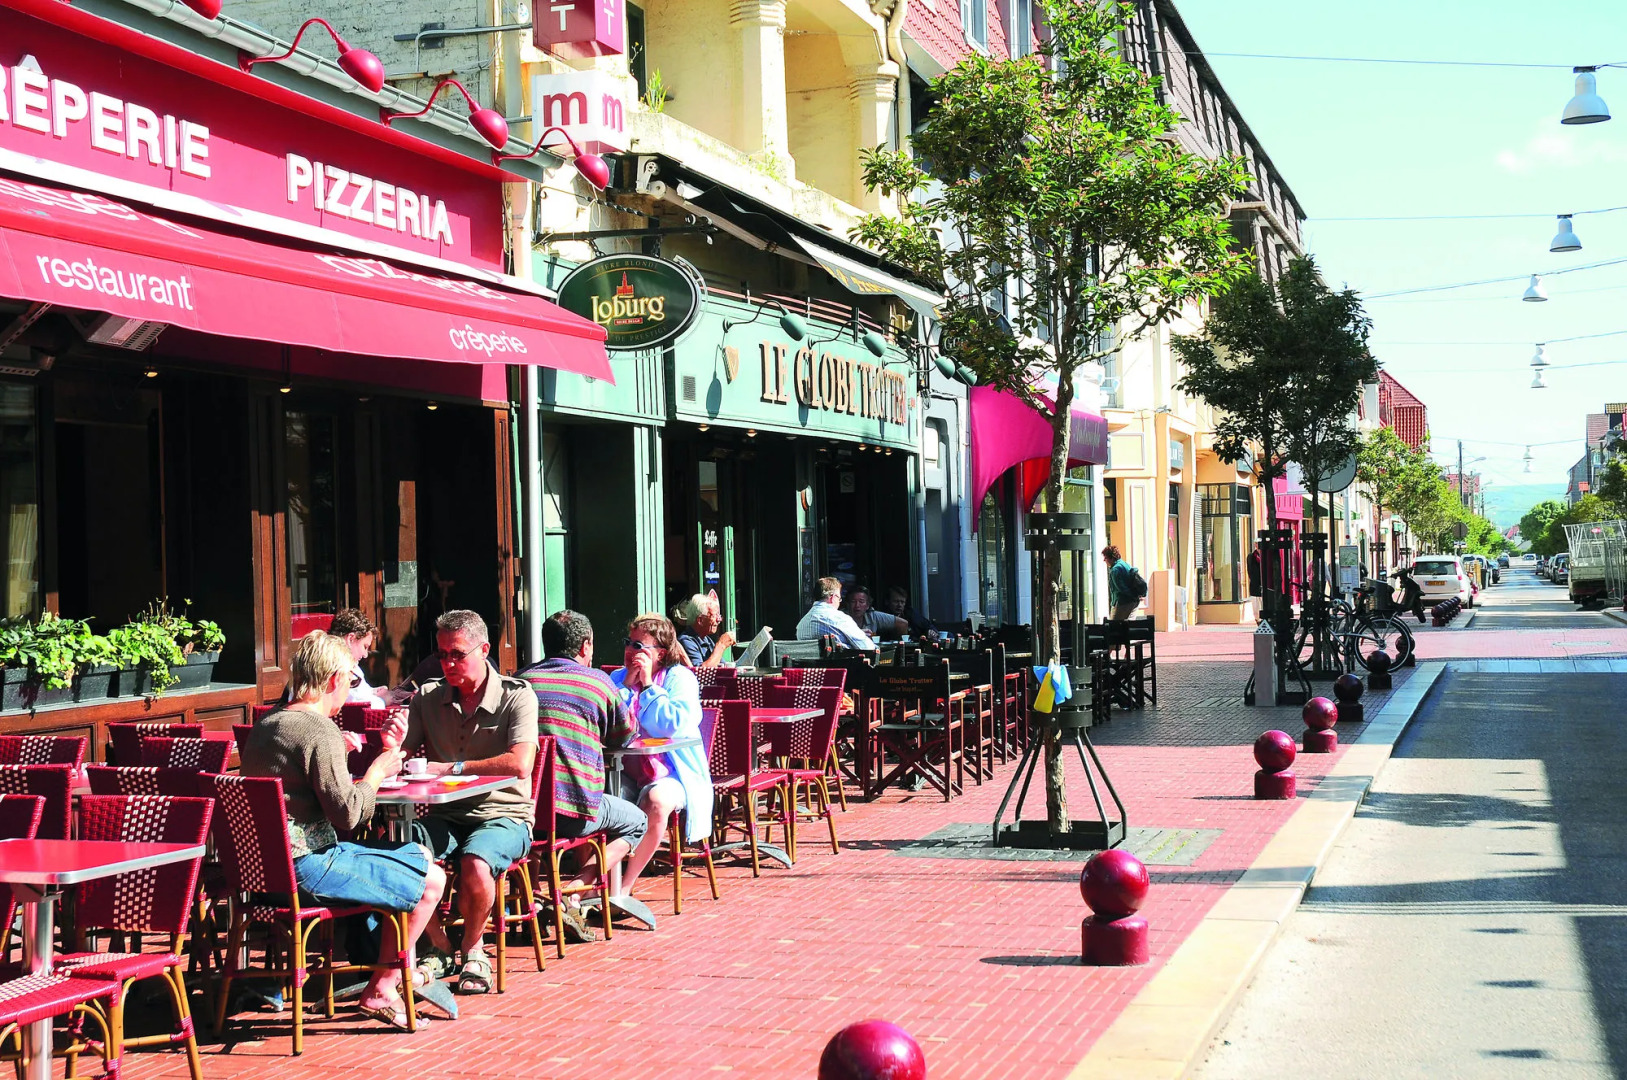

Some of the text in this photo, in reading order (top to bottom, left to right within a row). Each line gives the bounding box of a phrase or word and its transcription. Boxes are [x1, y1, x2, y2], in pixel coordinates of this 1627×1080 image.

[0, 54, 211, 178] ÊPERIE
[543, 92, 588, 128] m
[602, 92, 623, 133] m
[286, 152, 454, 245] PIZZERIA
[36, 254, 194, 311] restaurant
[590, 295, 665, 325] Loburg
[449, 323, 528, 357] crêperie
[760, 339, 791, 405] LE
[795, 345, 859, 415] GLOBE
